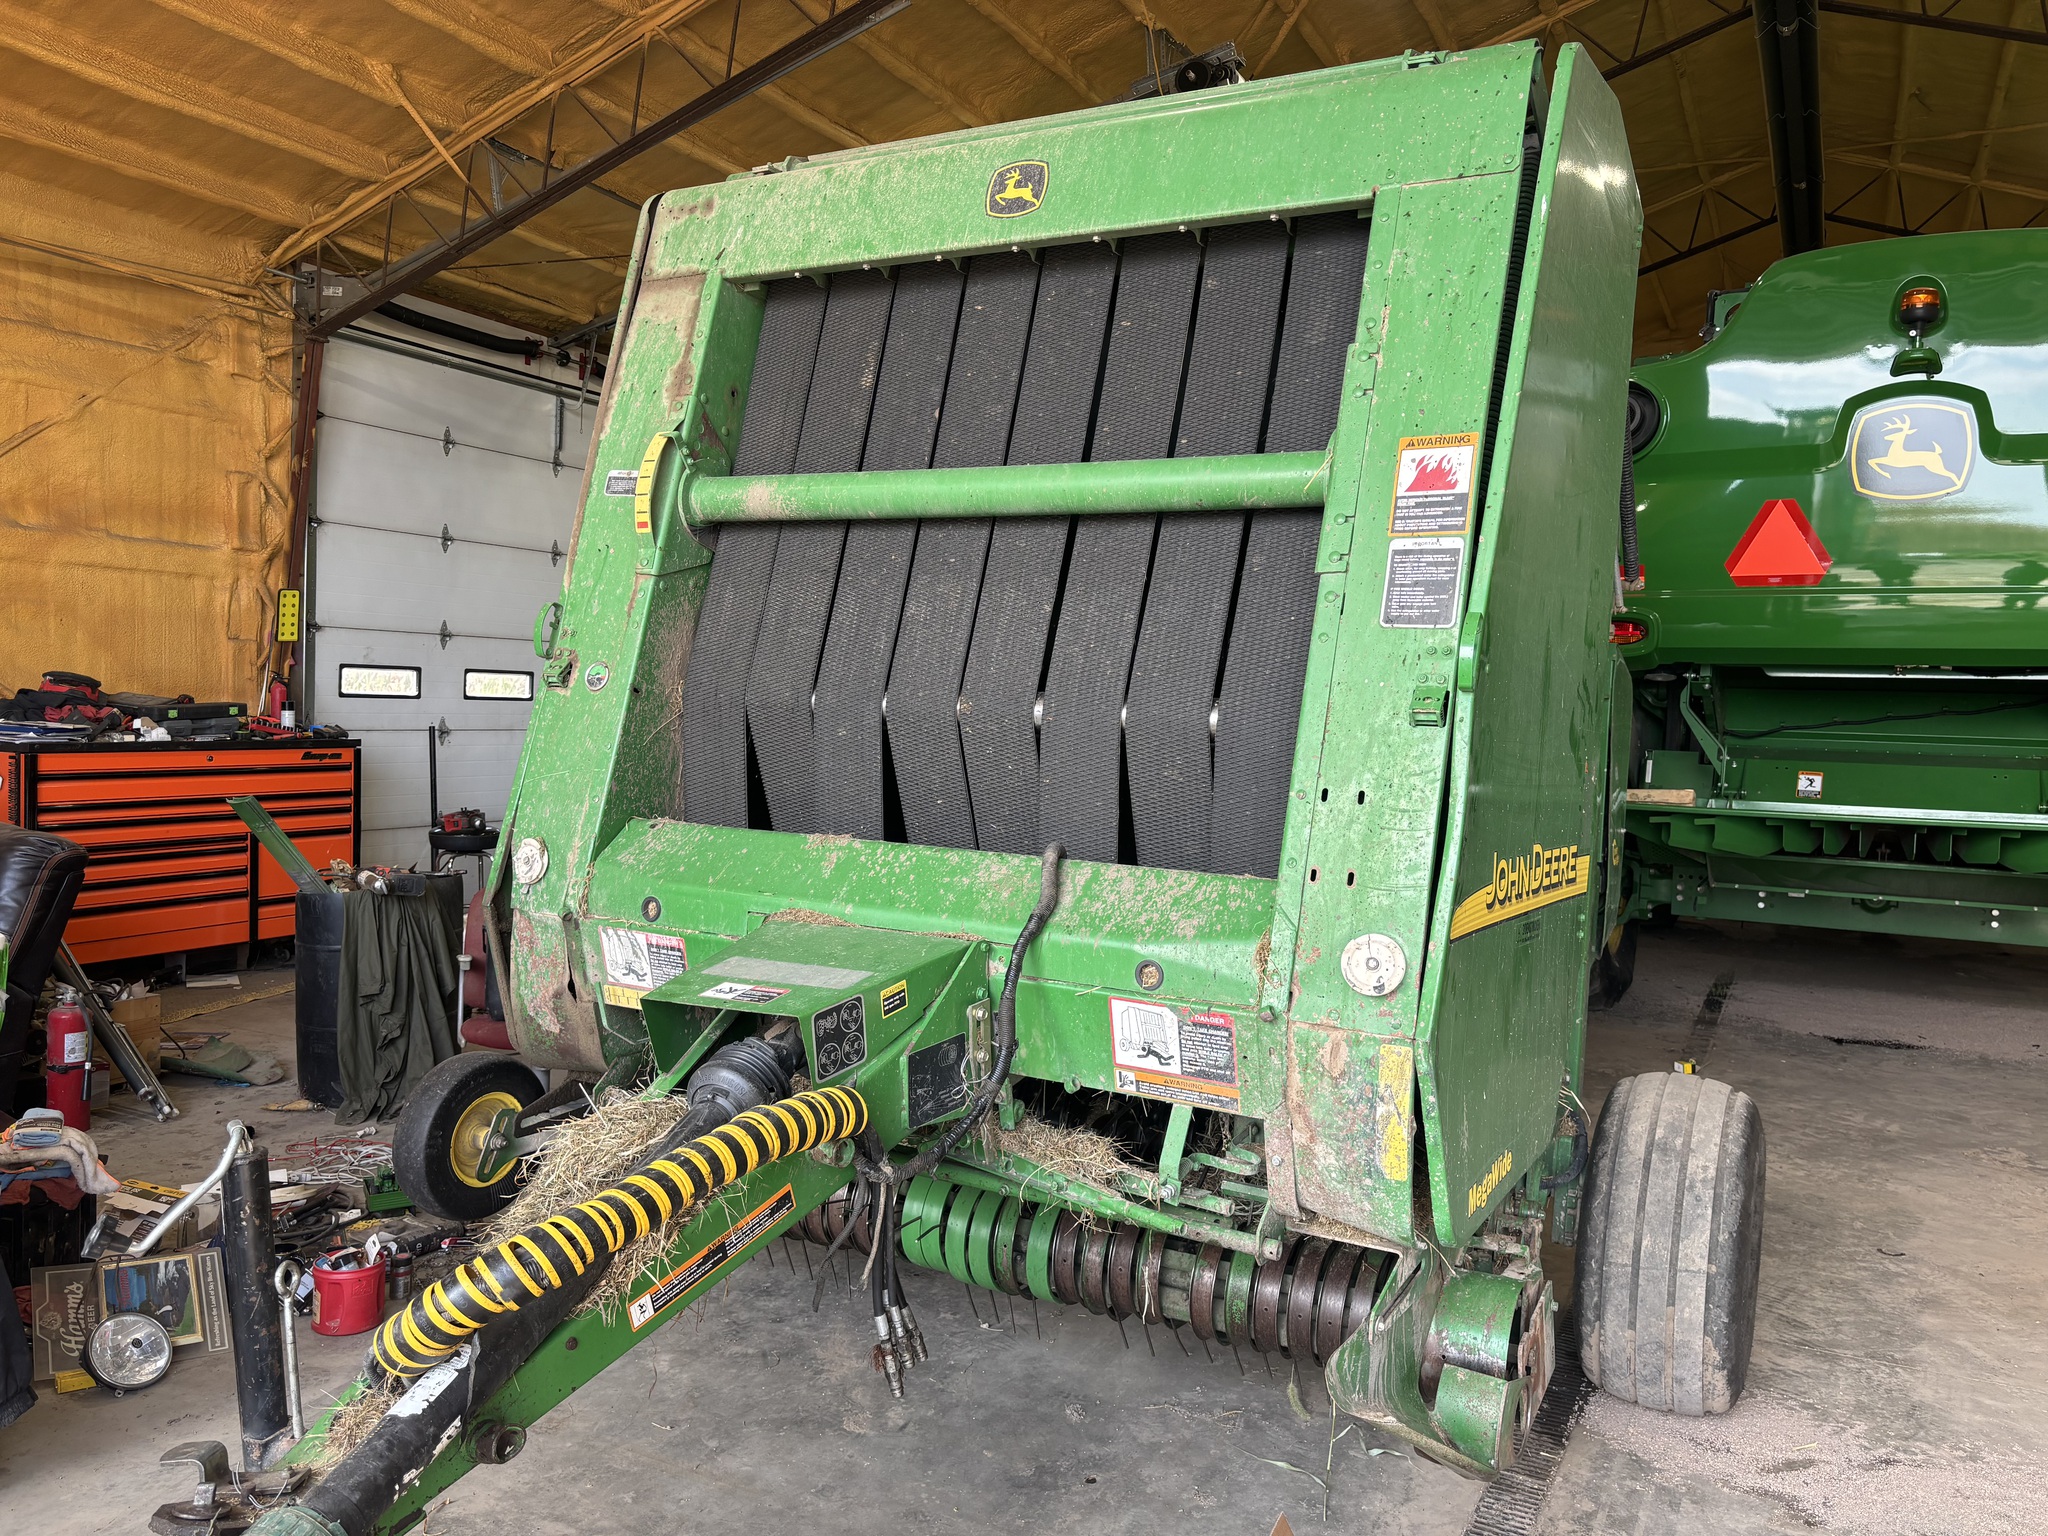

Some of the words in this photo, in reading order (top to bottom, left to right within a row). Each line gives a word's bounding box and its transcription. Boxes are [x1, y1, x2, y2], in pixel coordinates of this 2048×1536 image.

[1416, 434, 1471, 447] WARNING
[1486, 850, 1530, 911] JOHN
[1532, 843, 1577, 896] DEERE
[1195, 1014, 1225, 1025] DANGER
[1168, 1078, 1203, 1090] WARNING
[1468, 1148, 1513, 1219] MegaWide
[60, 1281, 87, 1357] Hamm's
[87, 1304, 100, 1330] BEER
